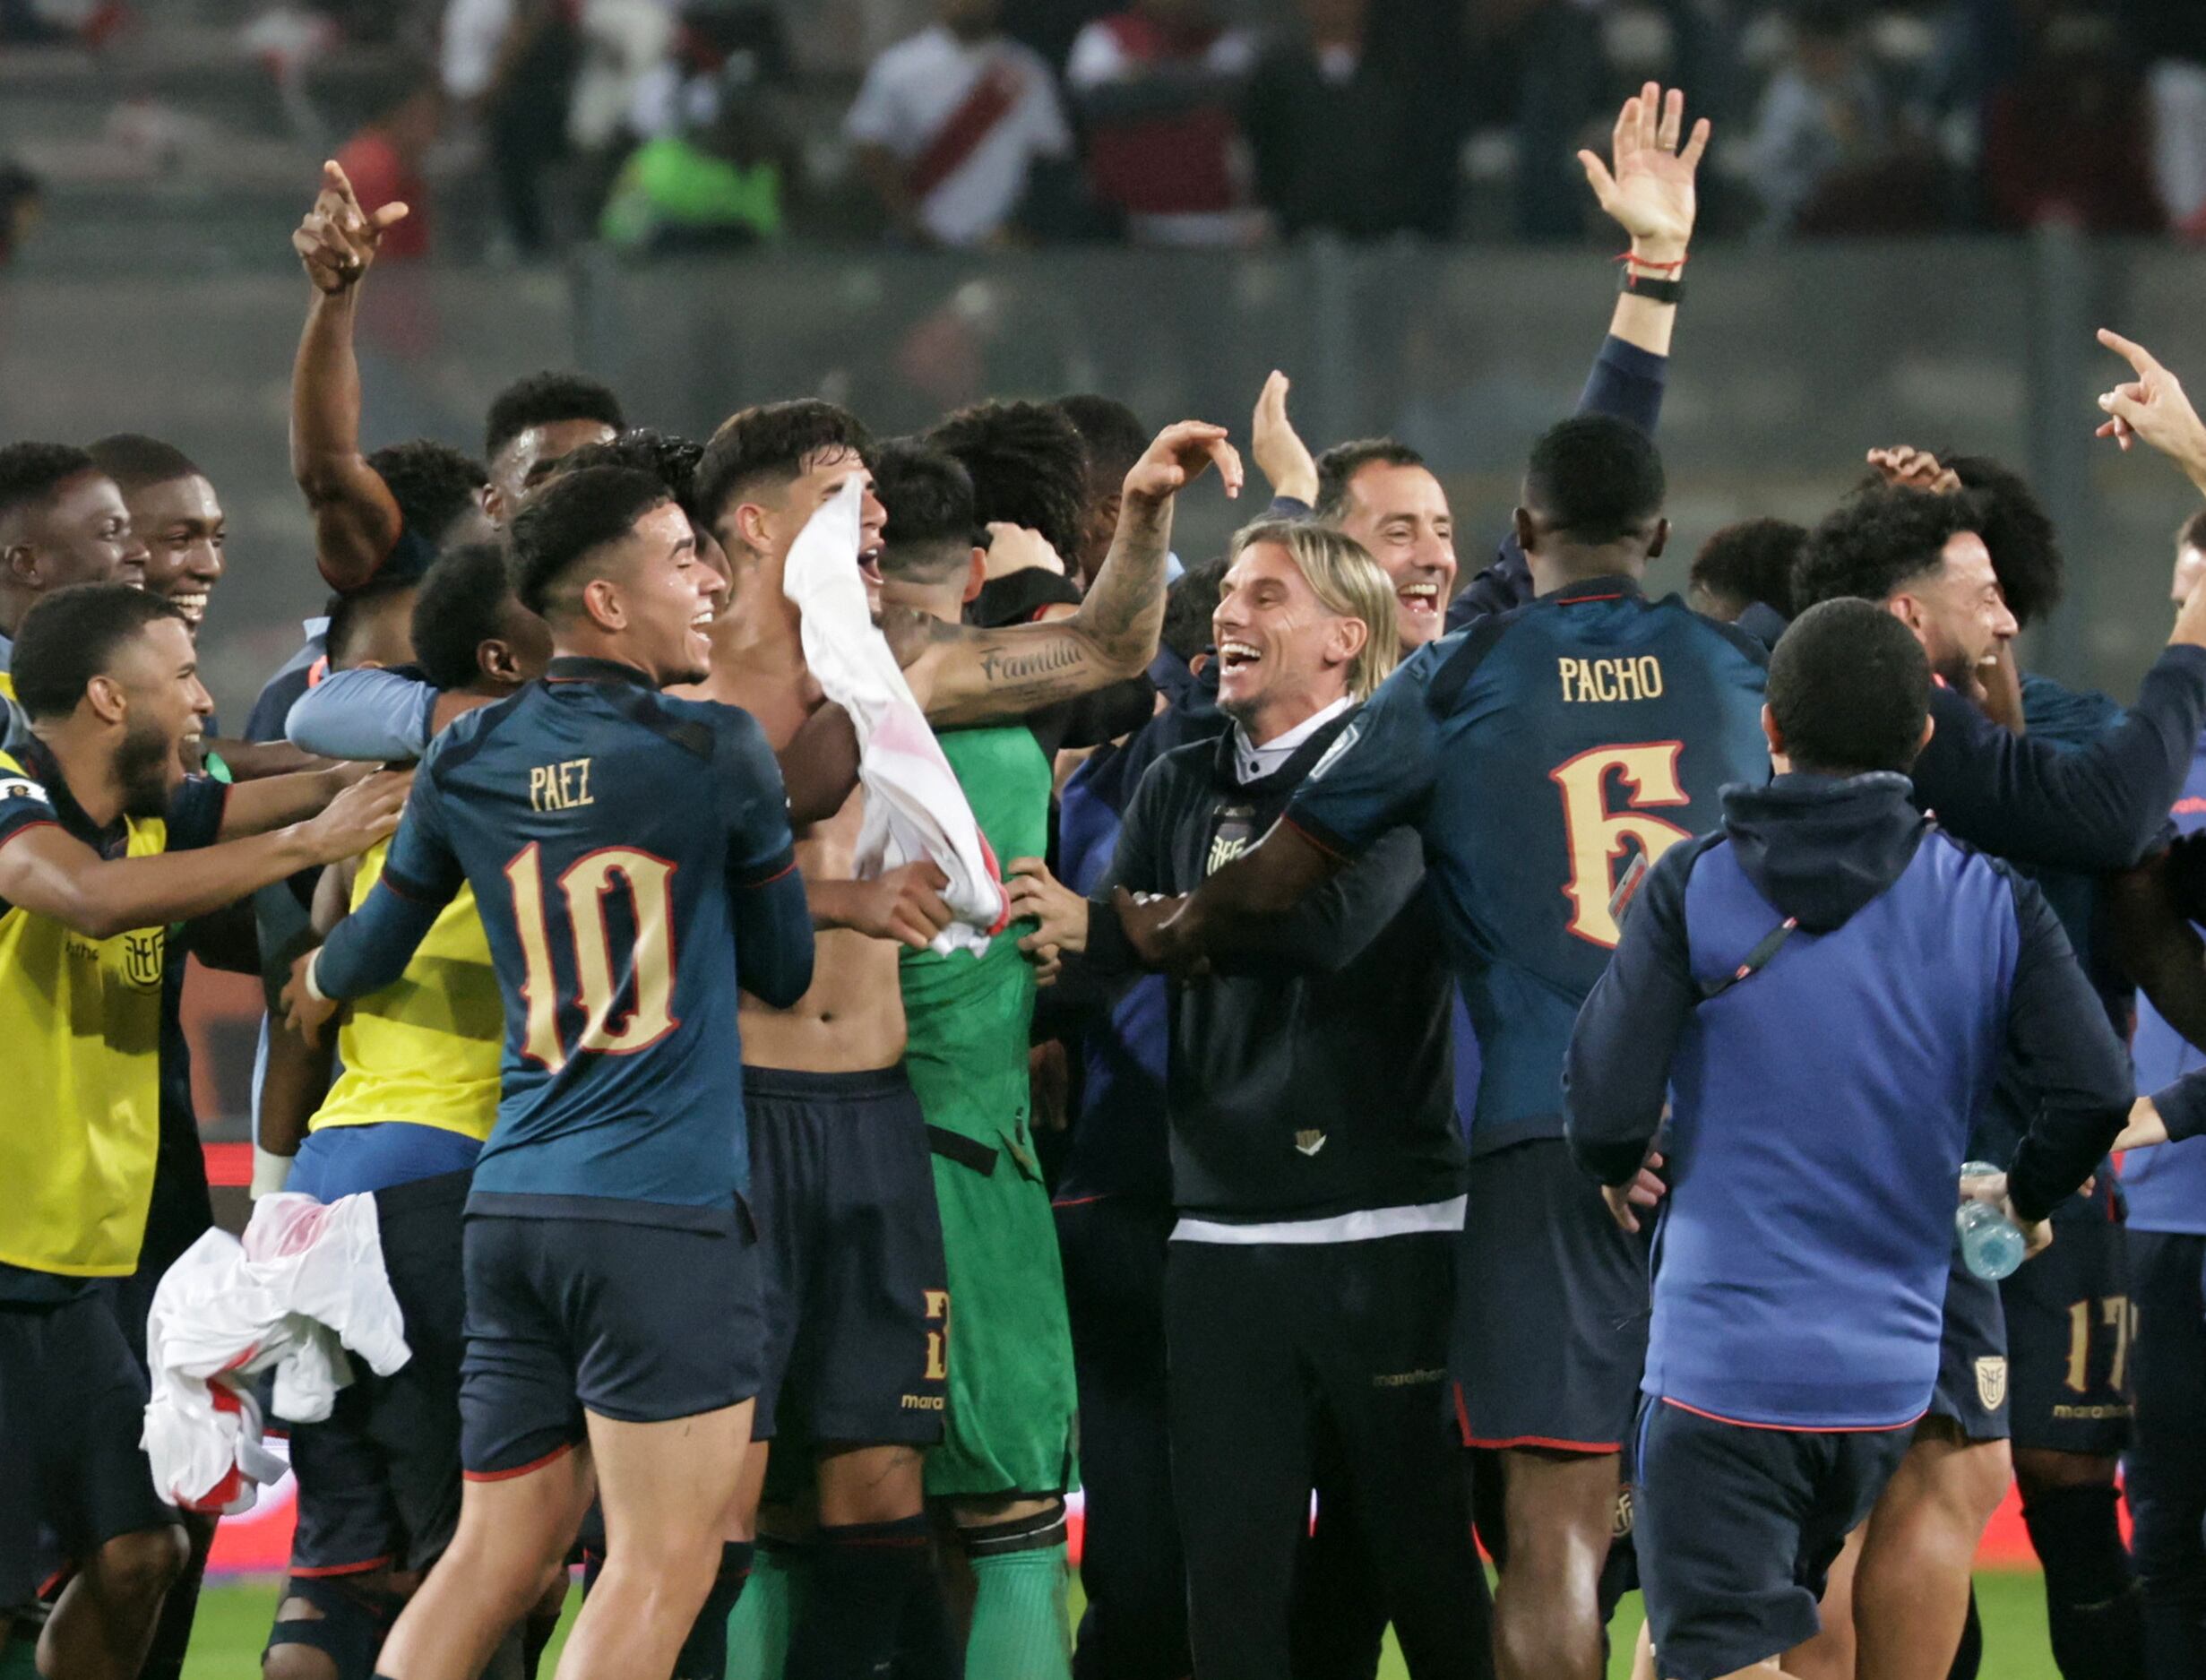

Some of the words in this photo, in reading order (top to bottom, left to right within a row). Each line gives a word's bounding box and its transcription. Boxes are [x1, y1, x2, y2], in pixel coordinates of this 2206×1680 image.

[1557, 655, 1664, 702] PACHO
[529, 757, 595, 812] PAEZ
[1547, 740, 1693, 951] 6
[502, 840, 681, 1076] 10
[2064, 1294, 2139, 1392] 17
